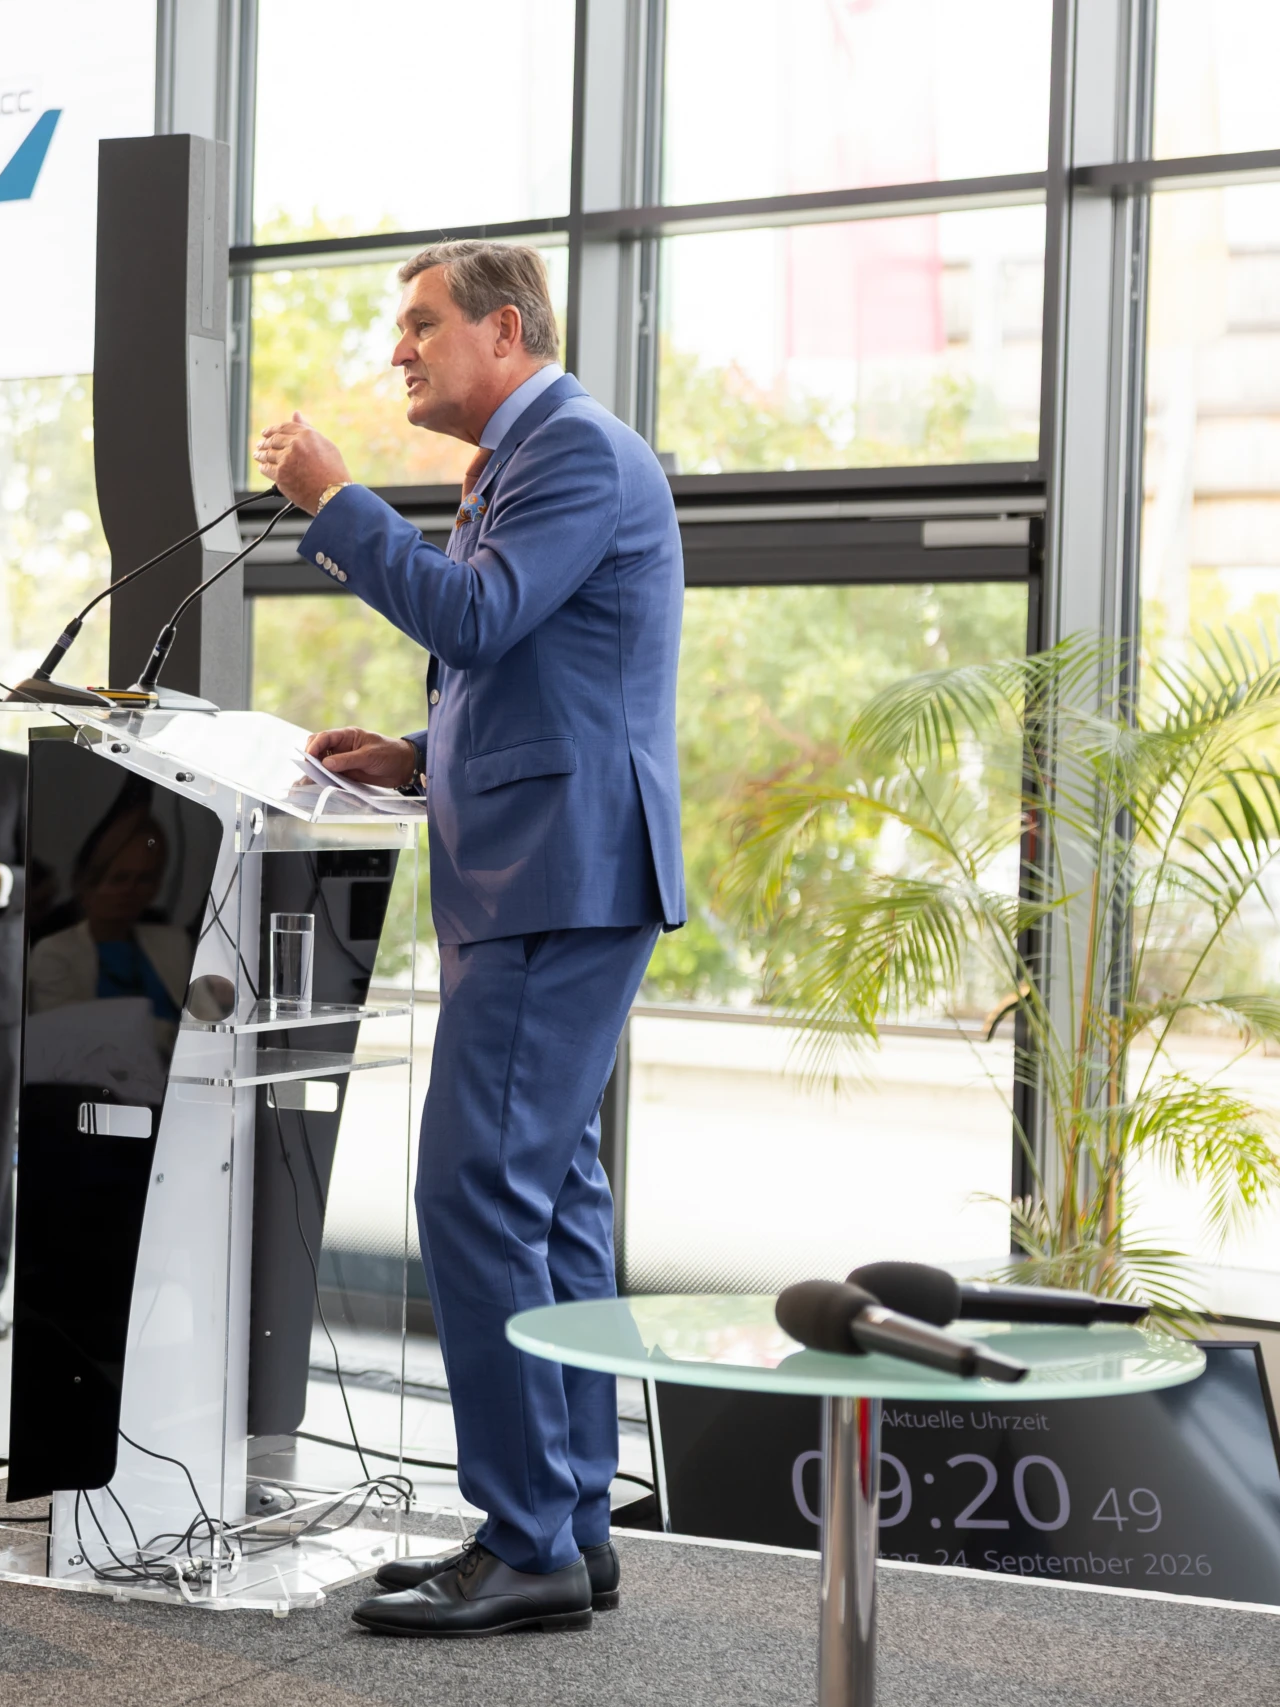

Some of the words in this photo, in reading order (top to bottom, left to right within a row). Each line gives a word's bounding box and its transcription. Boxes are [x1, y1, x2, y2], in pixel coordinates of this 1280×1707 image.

[880, 1410, 965, 1429] Aktuelle
[971, 1411, 1051, 1431] Uhrzeit
[1091, 1487, 1163, 1534] 49
[983, 1549, 1135, 1577] September
[1143, 1553, 1213, 1577] 2026
